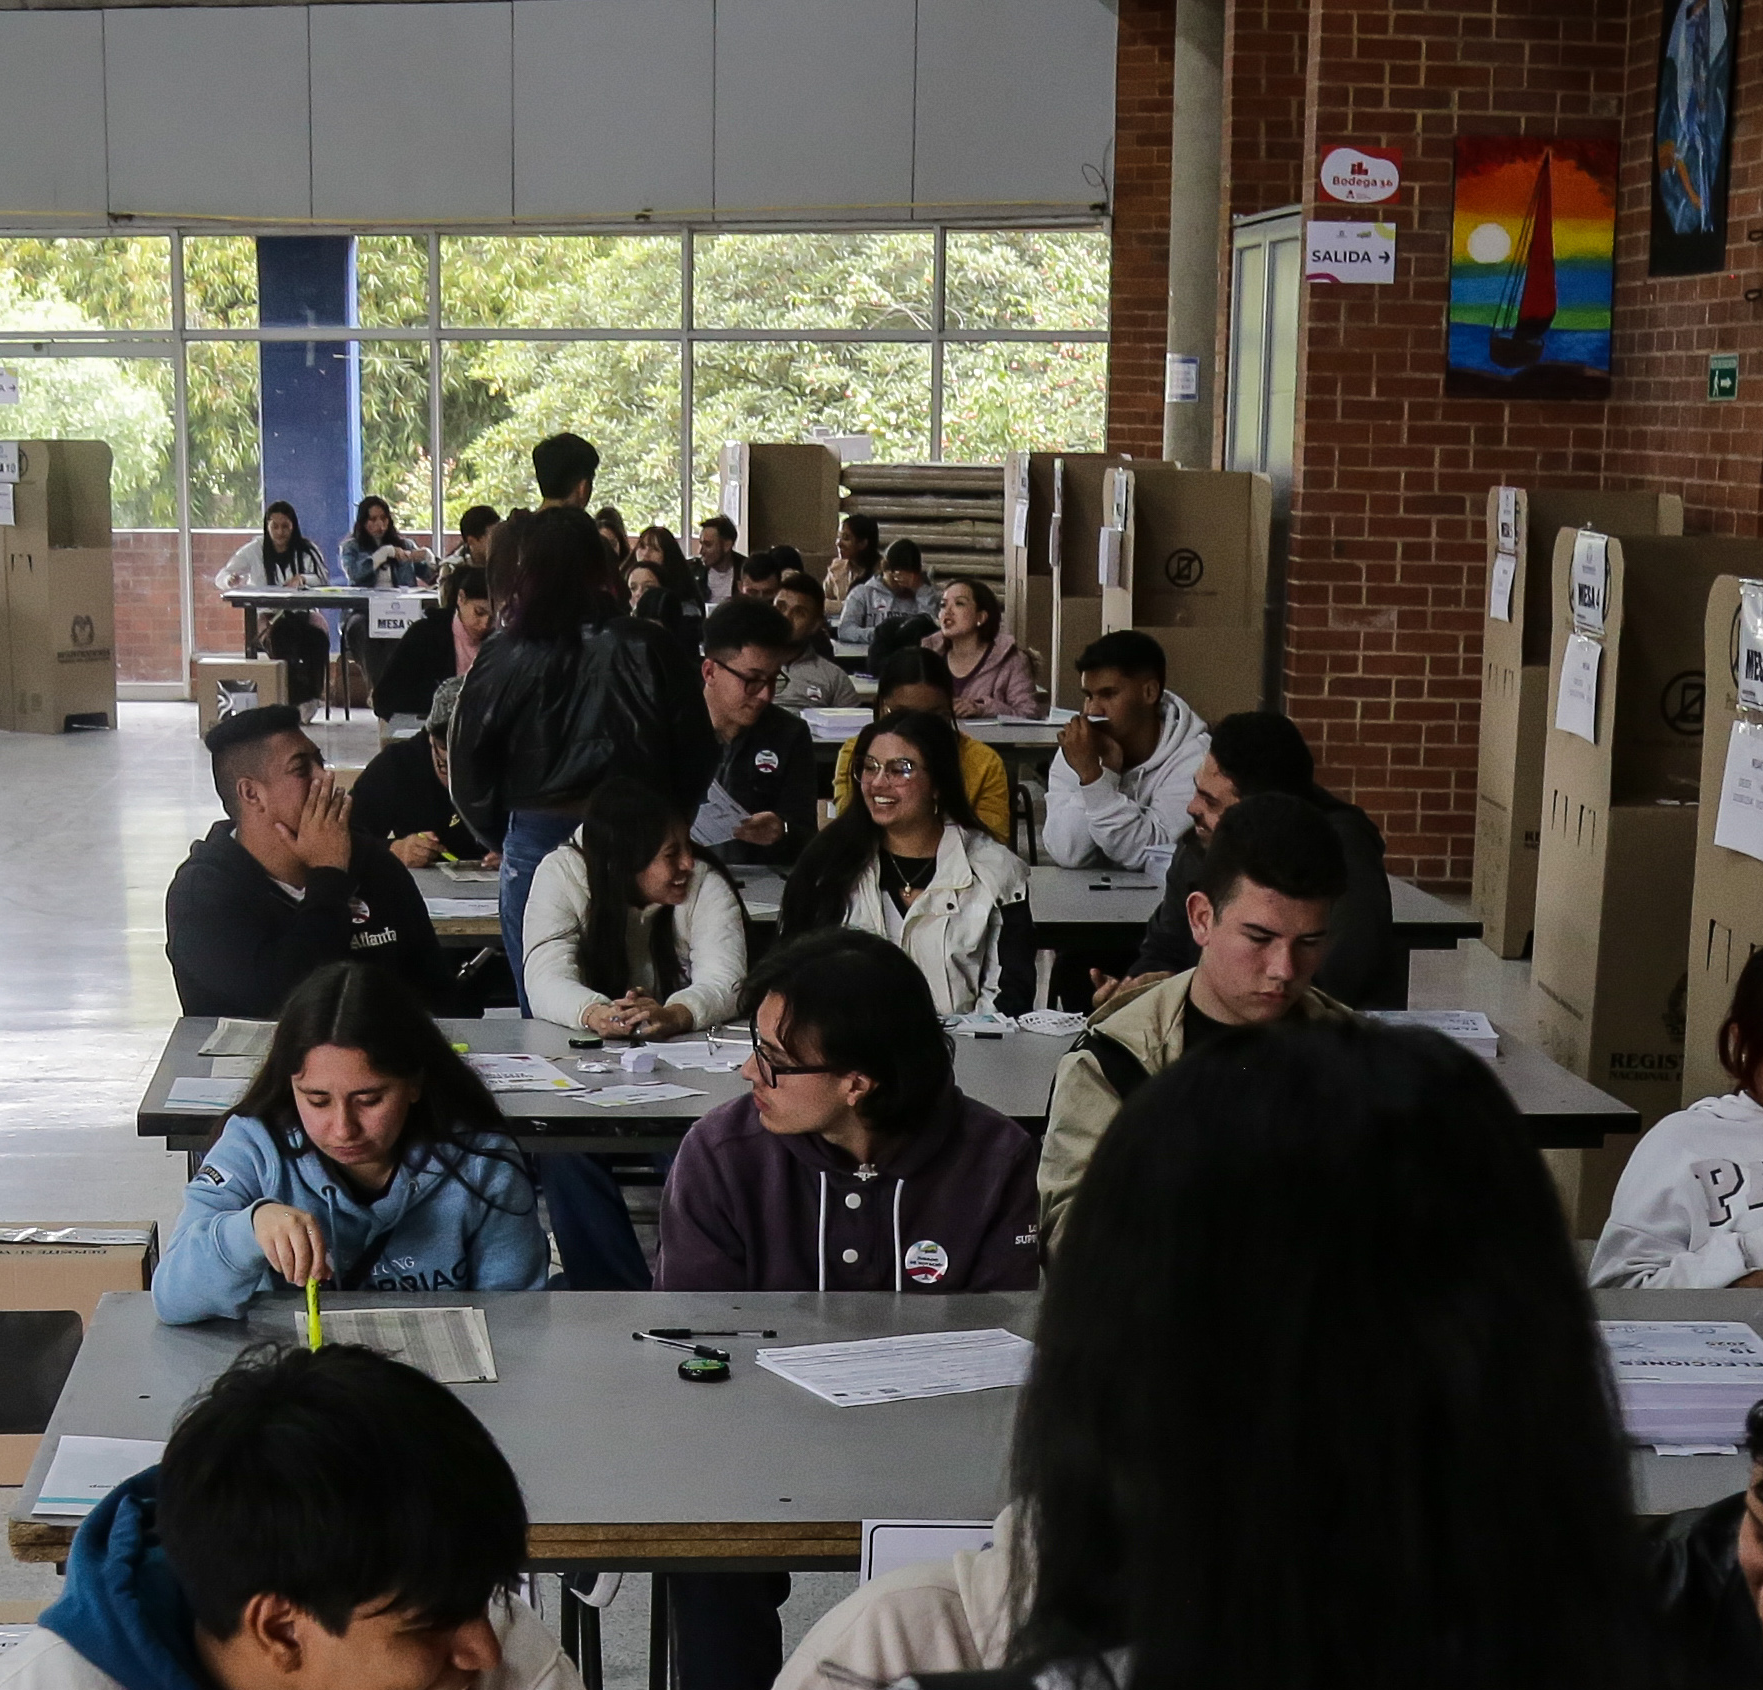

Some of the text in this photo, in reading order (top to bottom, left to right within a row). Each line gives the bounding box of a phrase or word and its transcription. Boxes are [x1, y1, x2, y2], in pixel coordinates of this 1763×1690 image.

[1311, 249, 1372, 263] SALIDA
[1577, 582, 1596, 610] MESA
[377, 618, 405, 629] MESA
